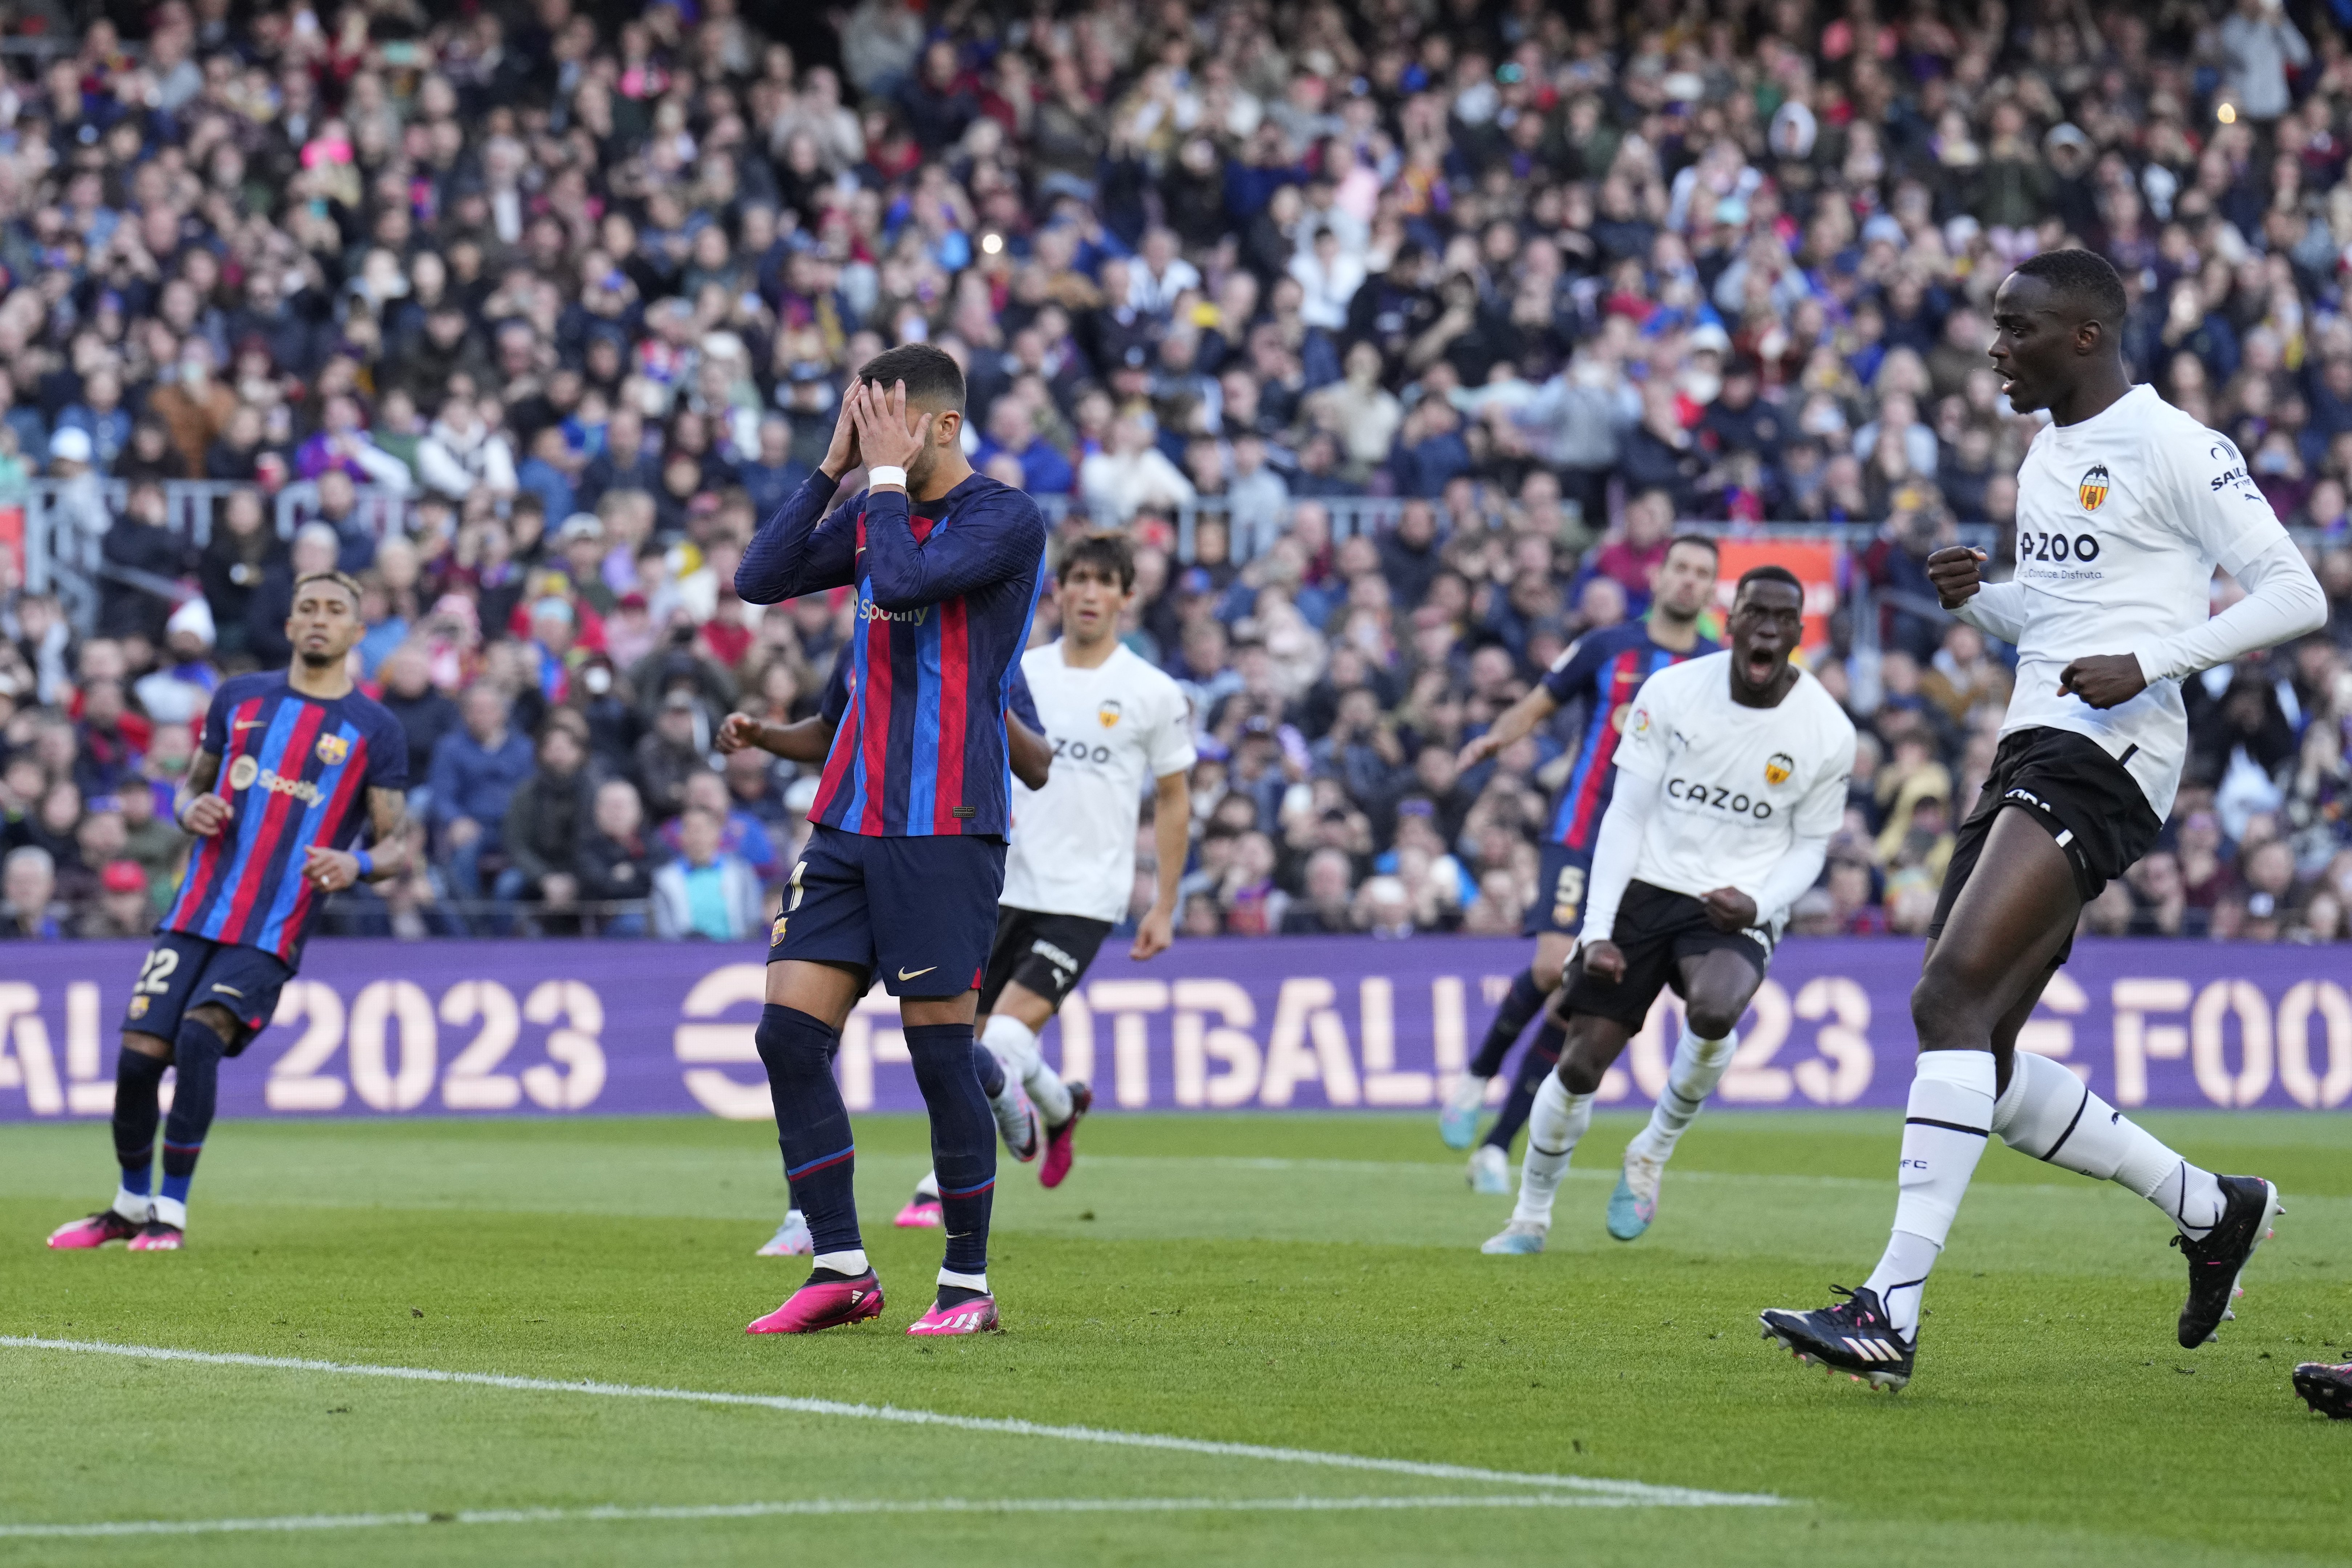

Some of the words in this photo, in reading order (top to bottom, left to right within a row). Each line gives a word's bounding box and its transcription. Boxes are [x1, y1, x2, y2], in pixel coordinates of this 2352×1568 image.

[2061, 570, 2104, 579] Disfruta.
[1668, 778, 1772, 819] CAZOO
[1555, 865, 1586, 903] 5
[265, 979, 607, 1111] 2023
[1593, 975, 1875, 1106] 023
